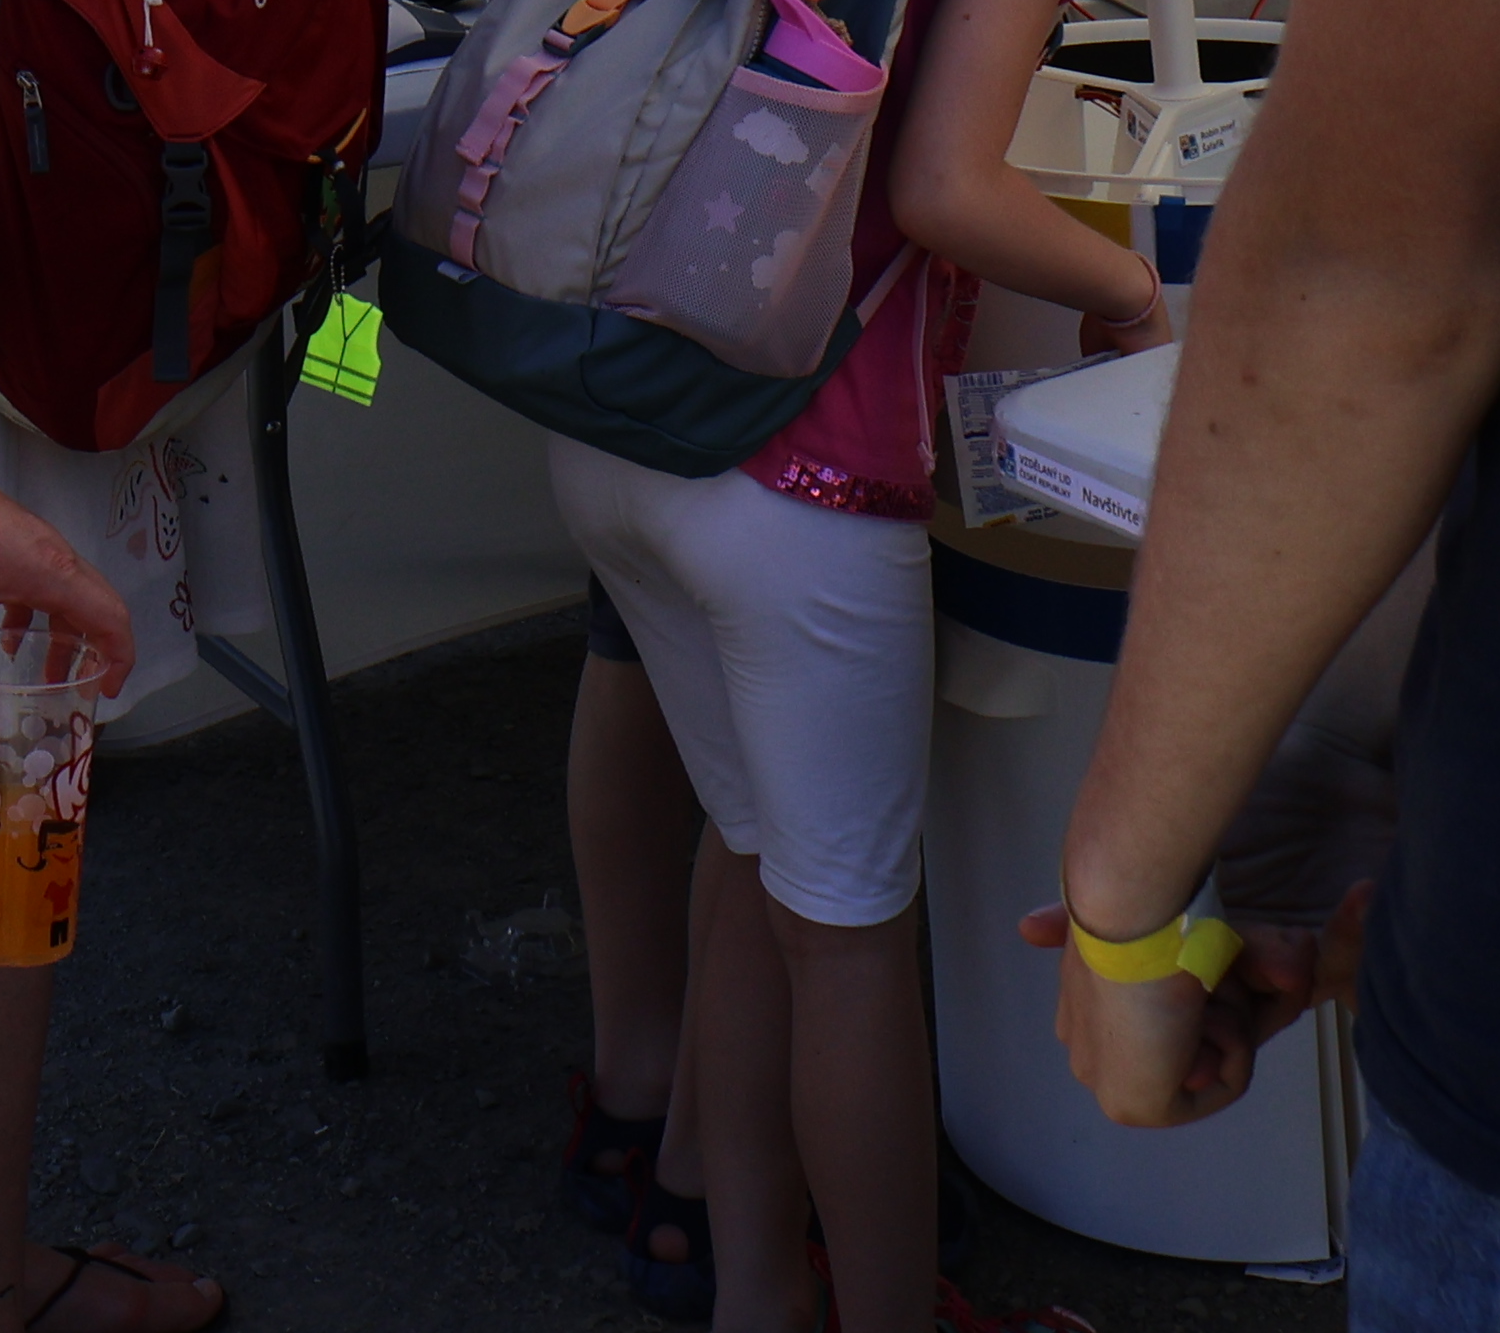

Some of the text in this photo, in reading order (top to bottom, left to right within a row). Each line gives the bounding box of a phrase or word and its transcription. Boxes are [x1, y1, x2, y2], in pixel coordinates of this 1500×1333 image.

[1018, 453, 1072, 486] VZDĚLANÝ LID
[1082, 487, 1140, 526] Navštivte
